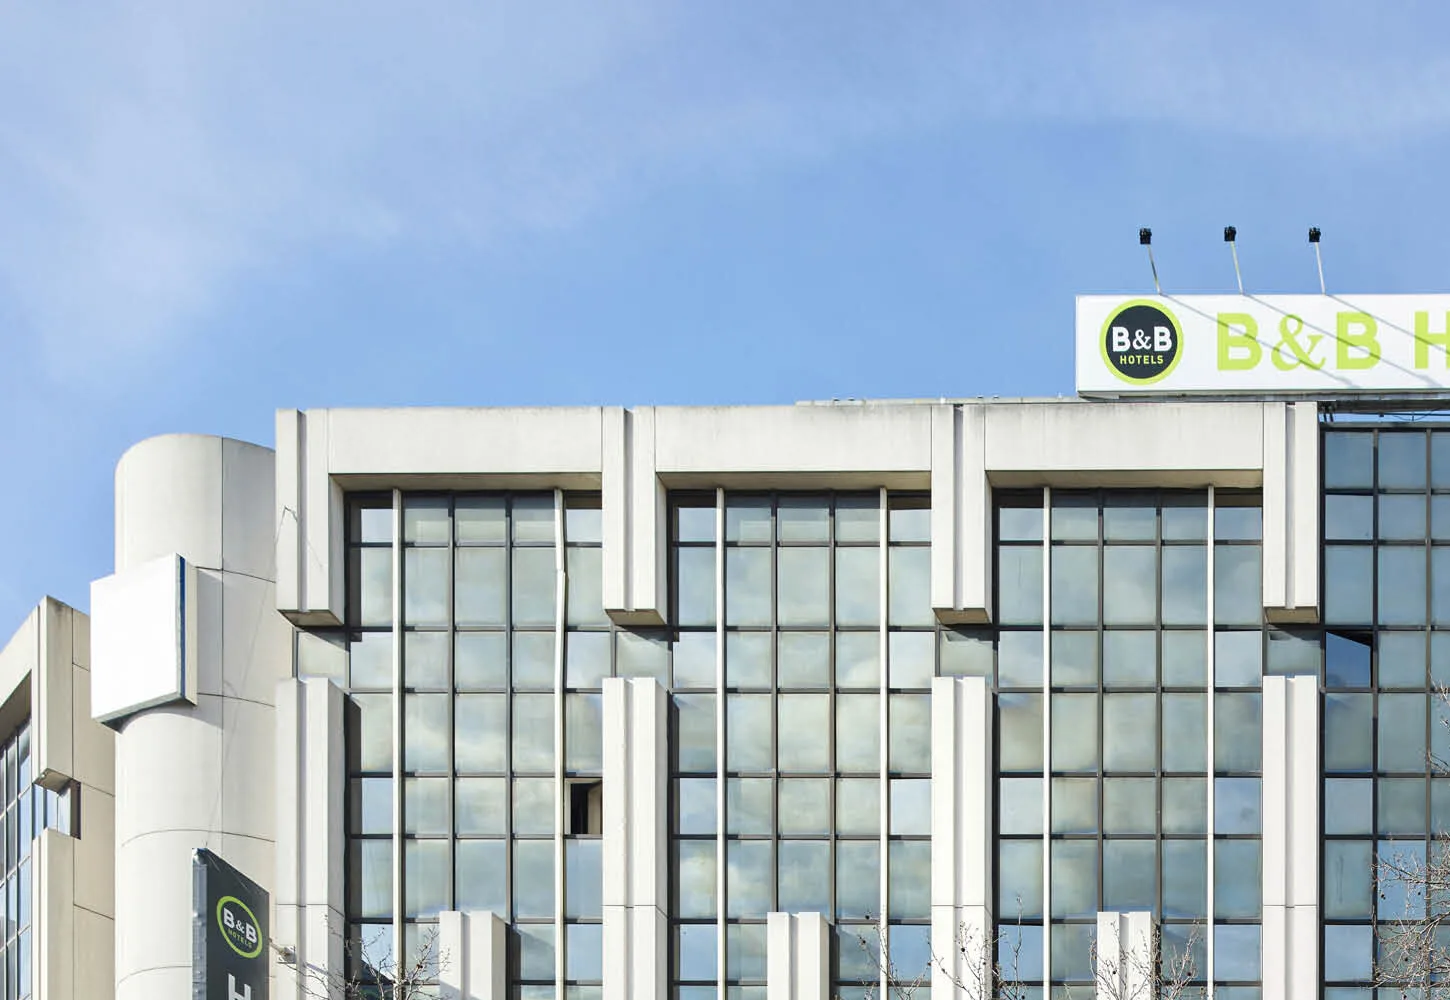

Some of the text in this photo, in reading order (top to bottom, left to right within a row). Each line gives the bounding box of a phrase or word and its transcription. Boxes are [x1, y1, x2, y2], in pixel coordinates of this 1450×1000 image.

[1112, 326, 1173, 352] B&B
[1216, 311, 1381, 372] B&B
[1119, 354, 1164, 365] HOTELS
[223, 907, 258, 944] B&B
[227, 927, 253, 949] HOTELS
